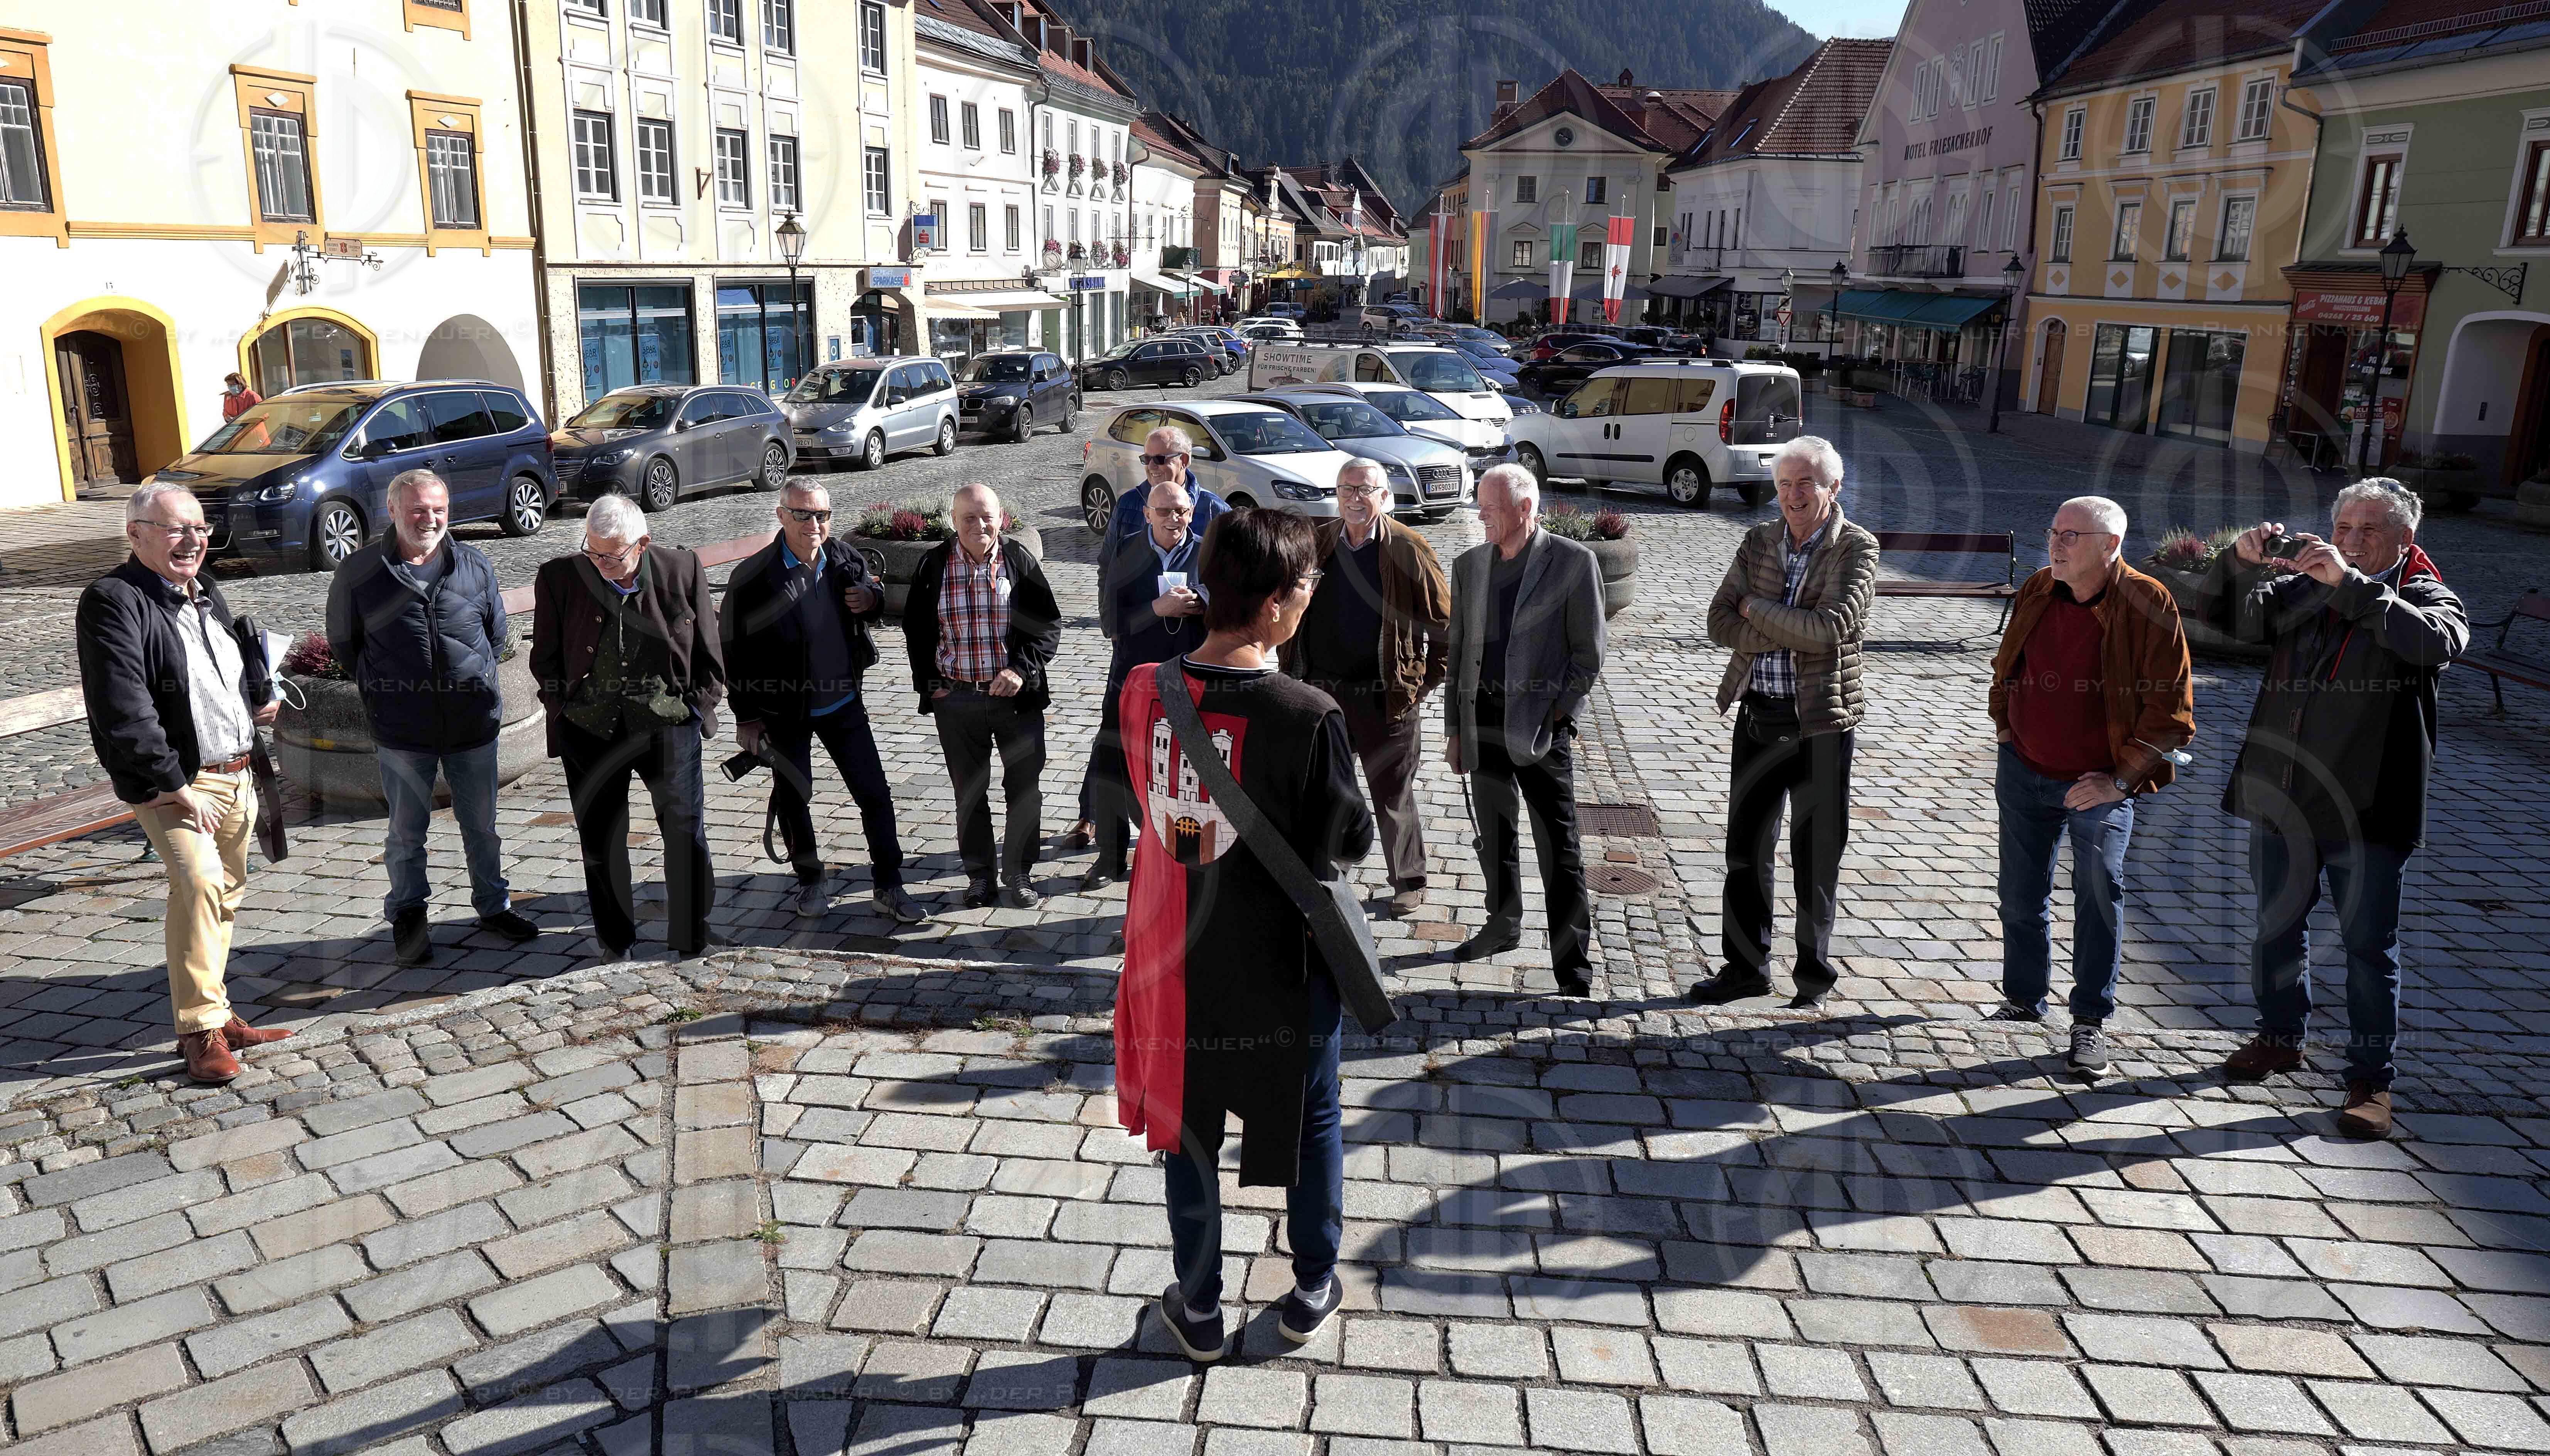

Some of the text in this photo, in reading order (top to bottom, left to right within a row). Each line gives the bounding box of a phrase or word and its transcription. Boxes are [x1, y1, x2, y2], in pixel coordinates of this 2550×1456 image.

[1904, 126, 1993, 160] HOTEL FRIESACHERHOF
[2320, 294, 2357, 304] PIZZAHAUS
[1263, 353, 1312, 364] SHOWTIME
